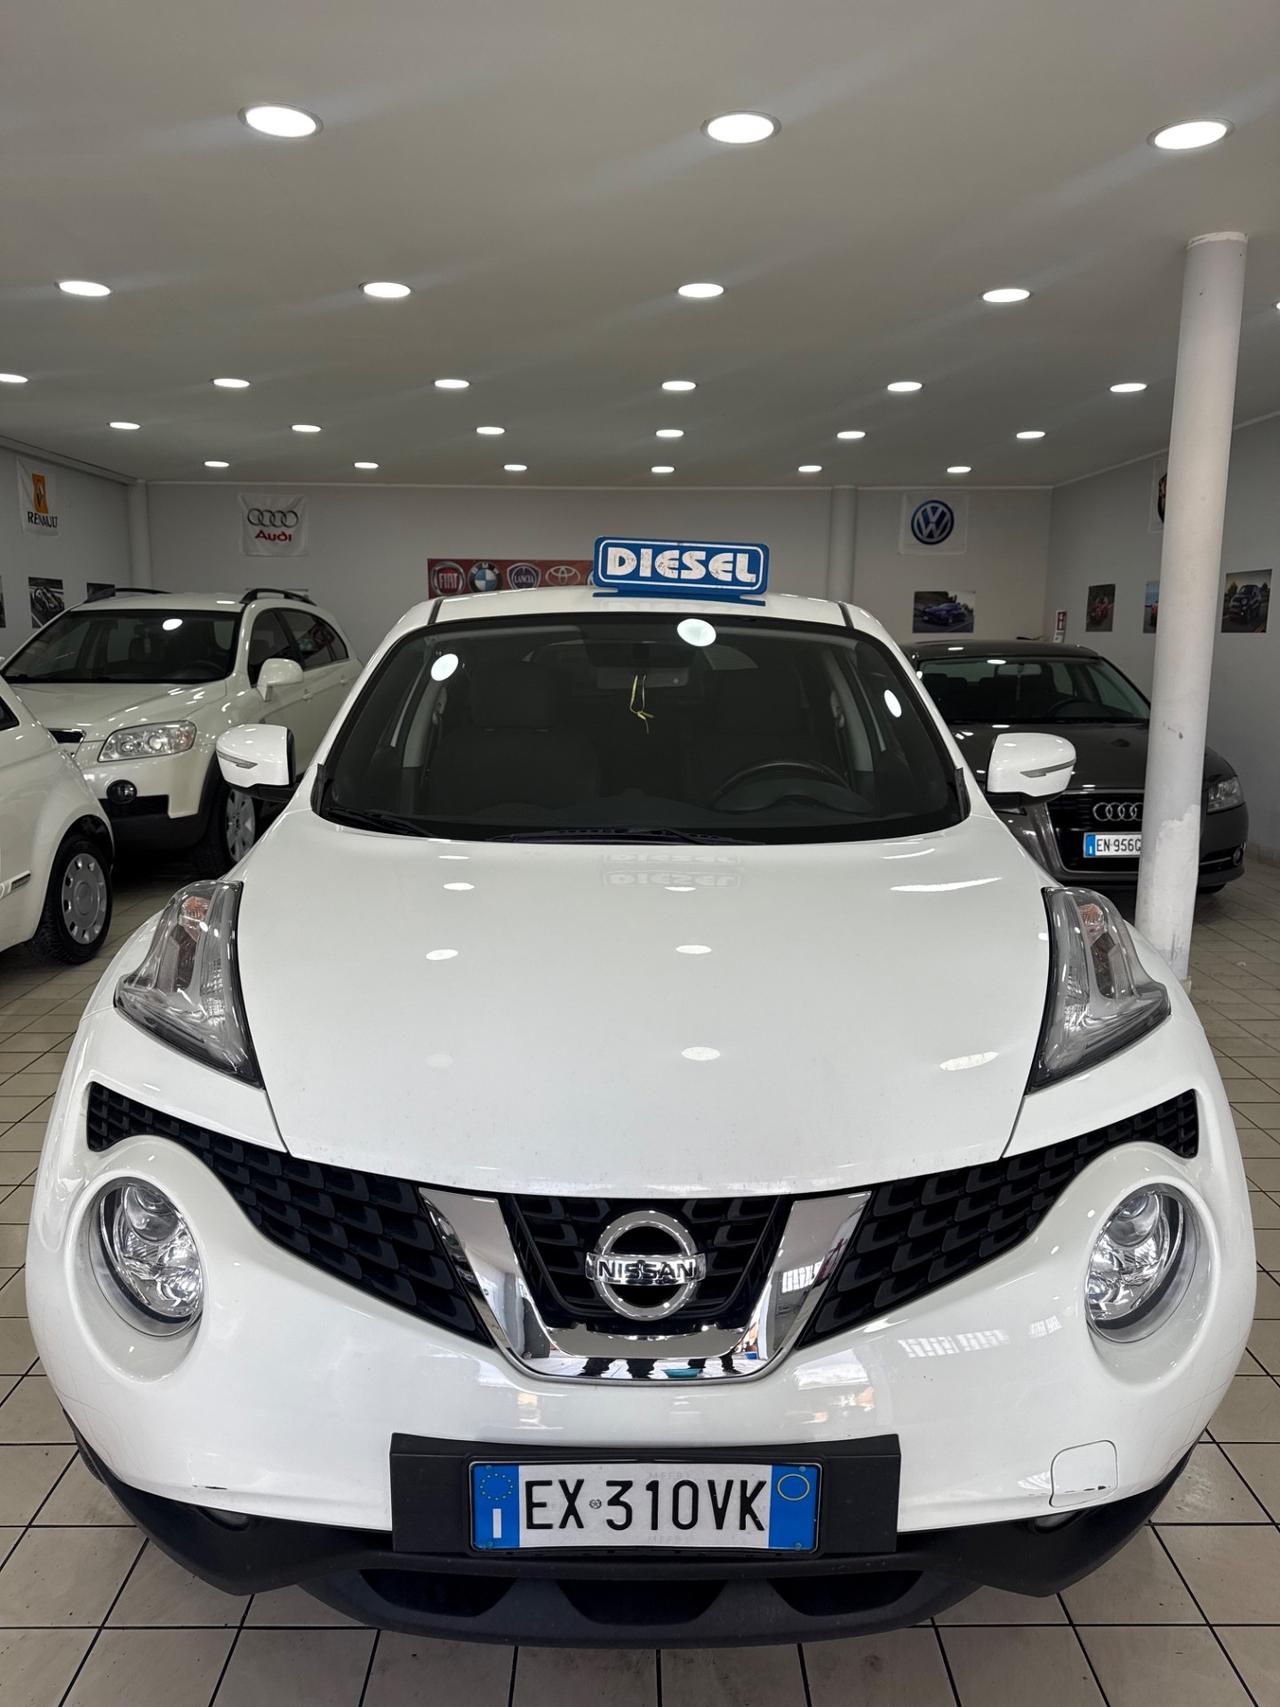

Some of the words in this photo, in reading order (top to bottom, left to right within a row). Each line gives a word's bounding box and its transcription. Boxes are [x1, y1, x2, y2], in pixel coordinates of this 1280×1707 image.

[27, 511, 58, 529] RENAULT
[255, 529, 292, 542] Audi
[605, 546, 757, 584] DIESEL
[438, 572, 458, 588] FIAT
[1096, 838, 1110, 852] EN
[598, 1259, 696, 1281] NISSAN
[524, 1478, 586, 1530] EX
[605, 1480, 767, 1531] 310VK
